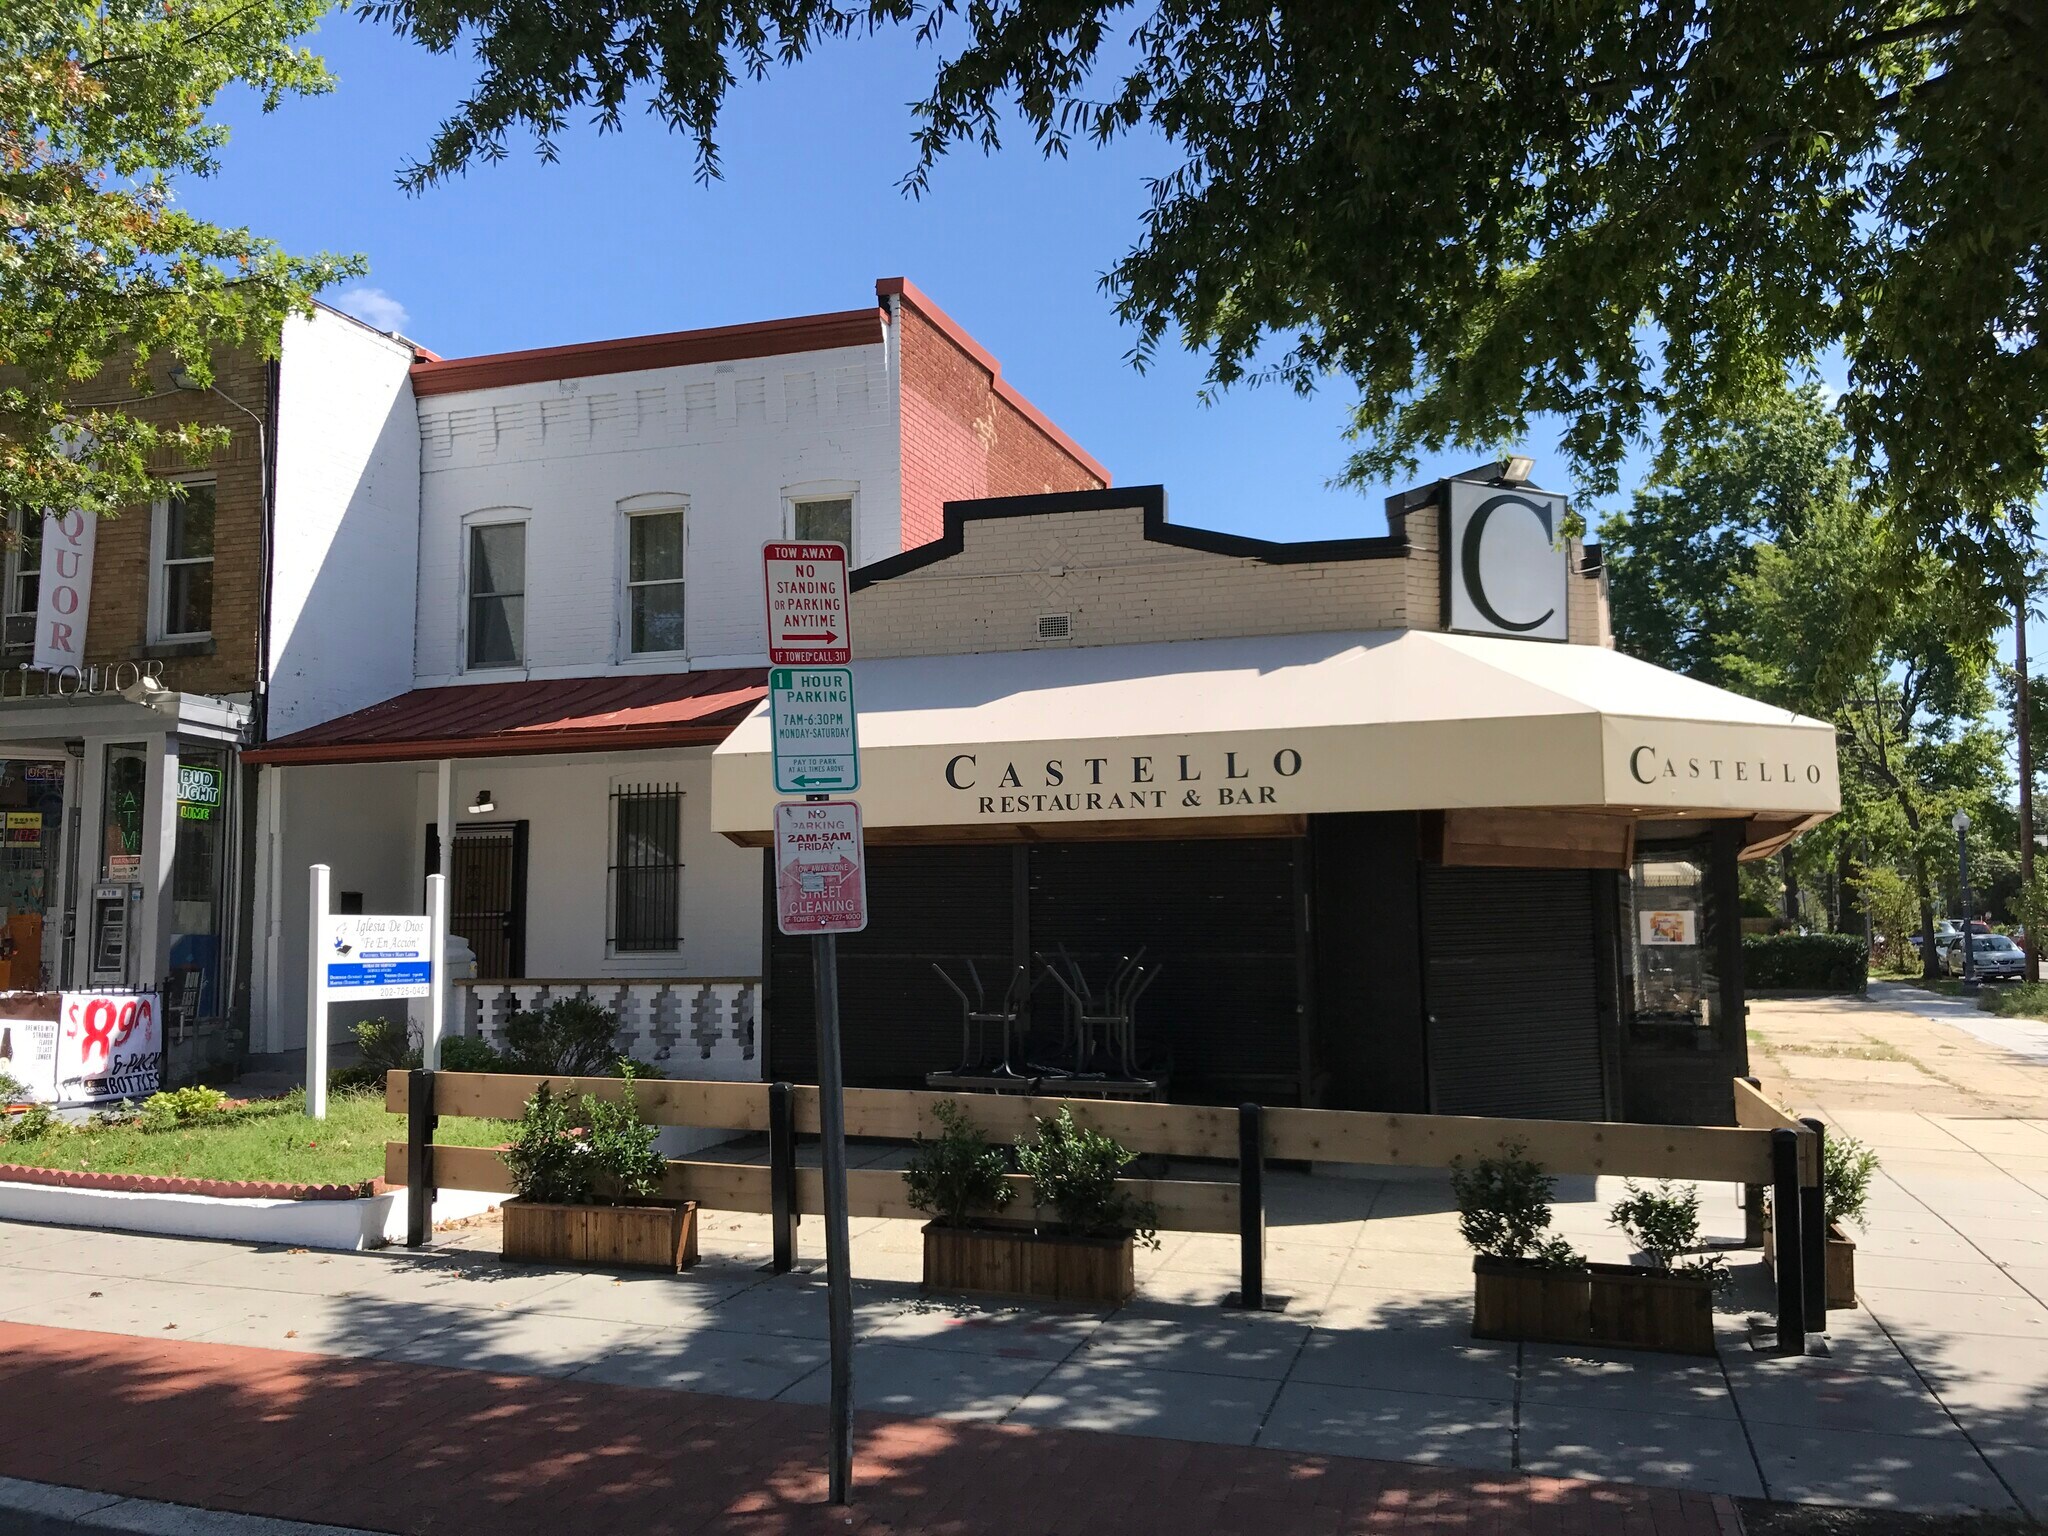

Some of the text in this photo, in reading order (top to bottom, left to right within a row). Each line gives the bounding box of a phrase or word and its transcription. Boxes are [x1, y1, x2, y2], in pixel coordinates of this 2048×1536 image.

[775, 547, 833, 559] TOW AWAY
[1461, 494, 1555, 632] C
[796, 565, 815, 578] NO
[48, 508, 85, 654] QUOR
[777, 581, 836, 594] STANDING
[775, 598, 840, 611] OR PARKING
[784, 615, 837, 627] ANYTIME
[775, 651, 846, 662] IF TOWED CALL 311
[776, 672, 843, 688] 1 HOUR
[787, 691, 847, 703] PARKING
[783, 713, 843, 725] 7AM-6:30PM
[779, 727, 850, 739] MONDAY-SATURDAY
[945, 747, 1303, 791] CASTELLO
[1629, 745, 1821, 785] CASTELLO
[181, 769, 213, 787] BUD
[176, 783, 218, 802] LIGHT
[978, 785, 1278, 814] RESTAURANT & BAR
[180, 805, 210, 820] LIME
[808, 810, 827, 819] NO
[121, 790, 136, 849] ATM
[792, 820, 845, 830] PARKING
[788, 832, 851, 843] 2AM-5AM
[798, 842, 835, 851] FRIDAY
[811, 864, 828, 873] AWAY
[830, 863, 849, 871] ZONE
[789, 899, 854, 914] CLEANING
[793, 915, 815, 923] TOWED
[356, 918, 424, 936] Iglesia De Dios
[377, 937, 388, 948] En
[108, 1072, 161, 1095] BOTTLES
